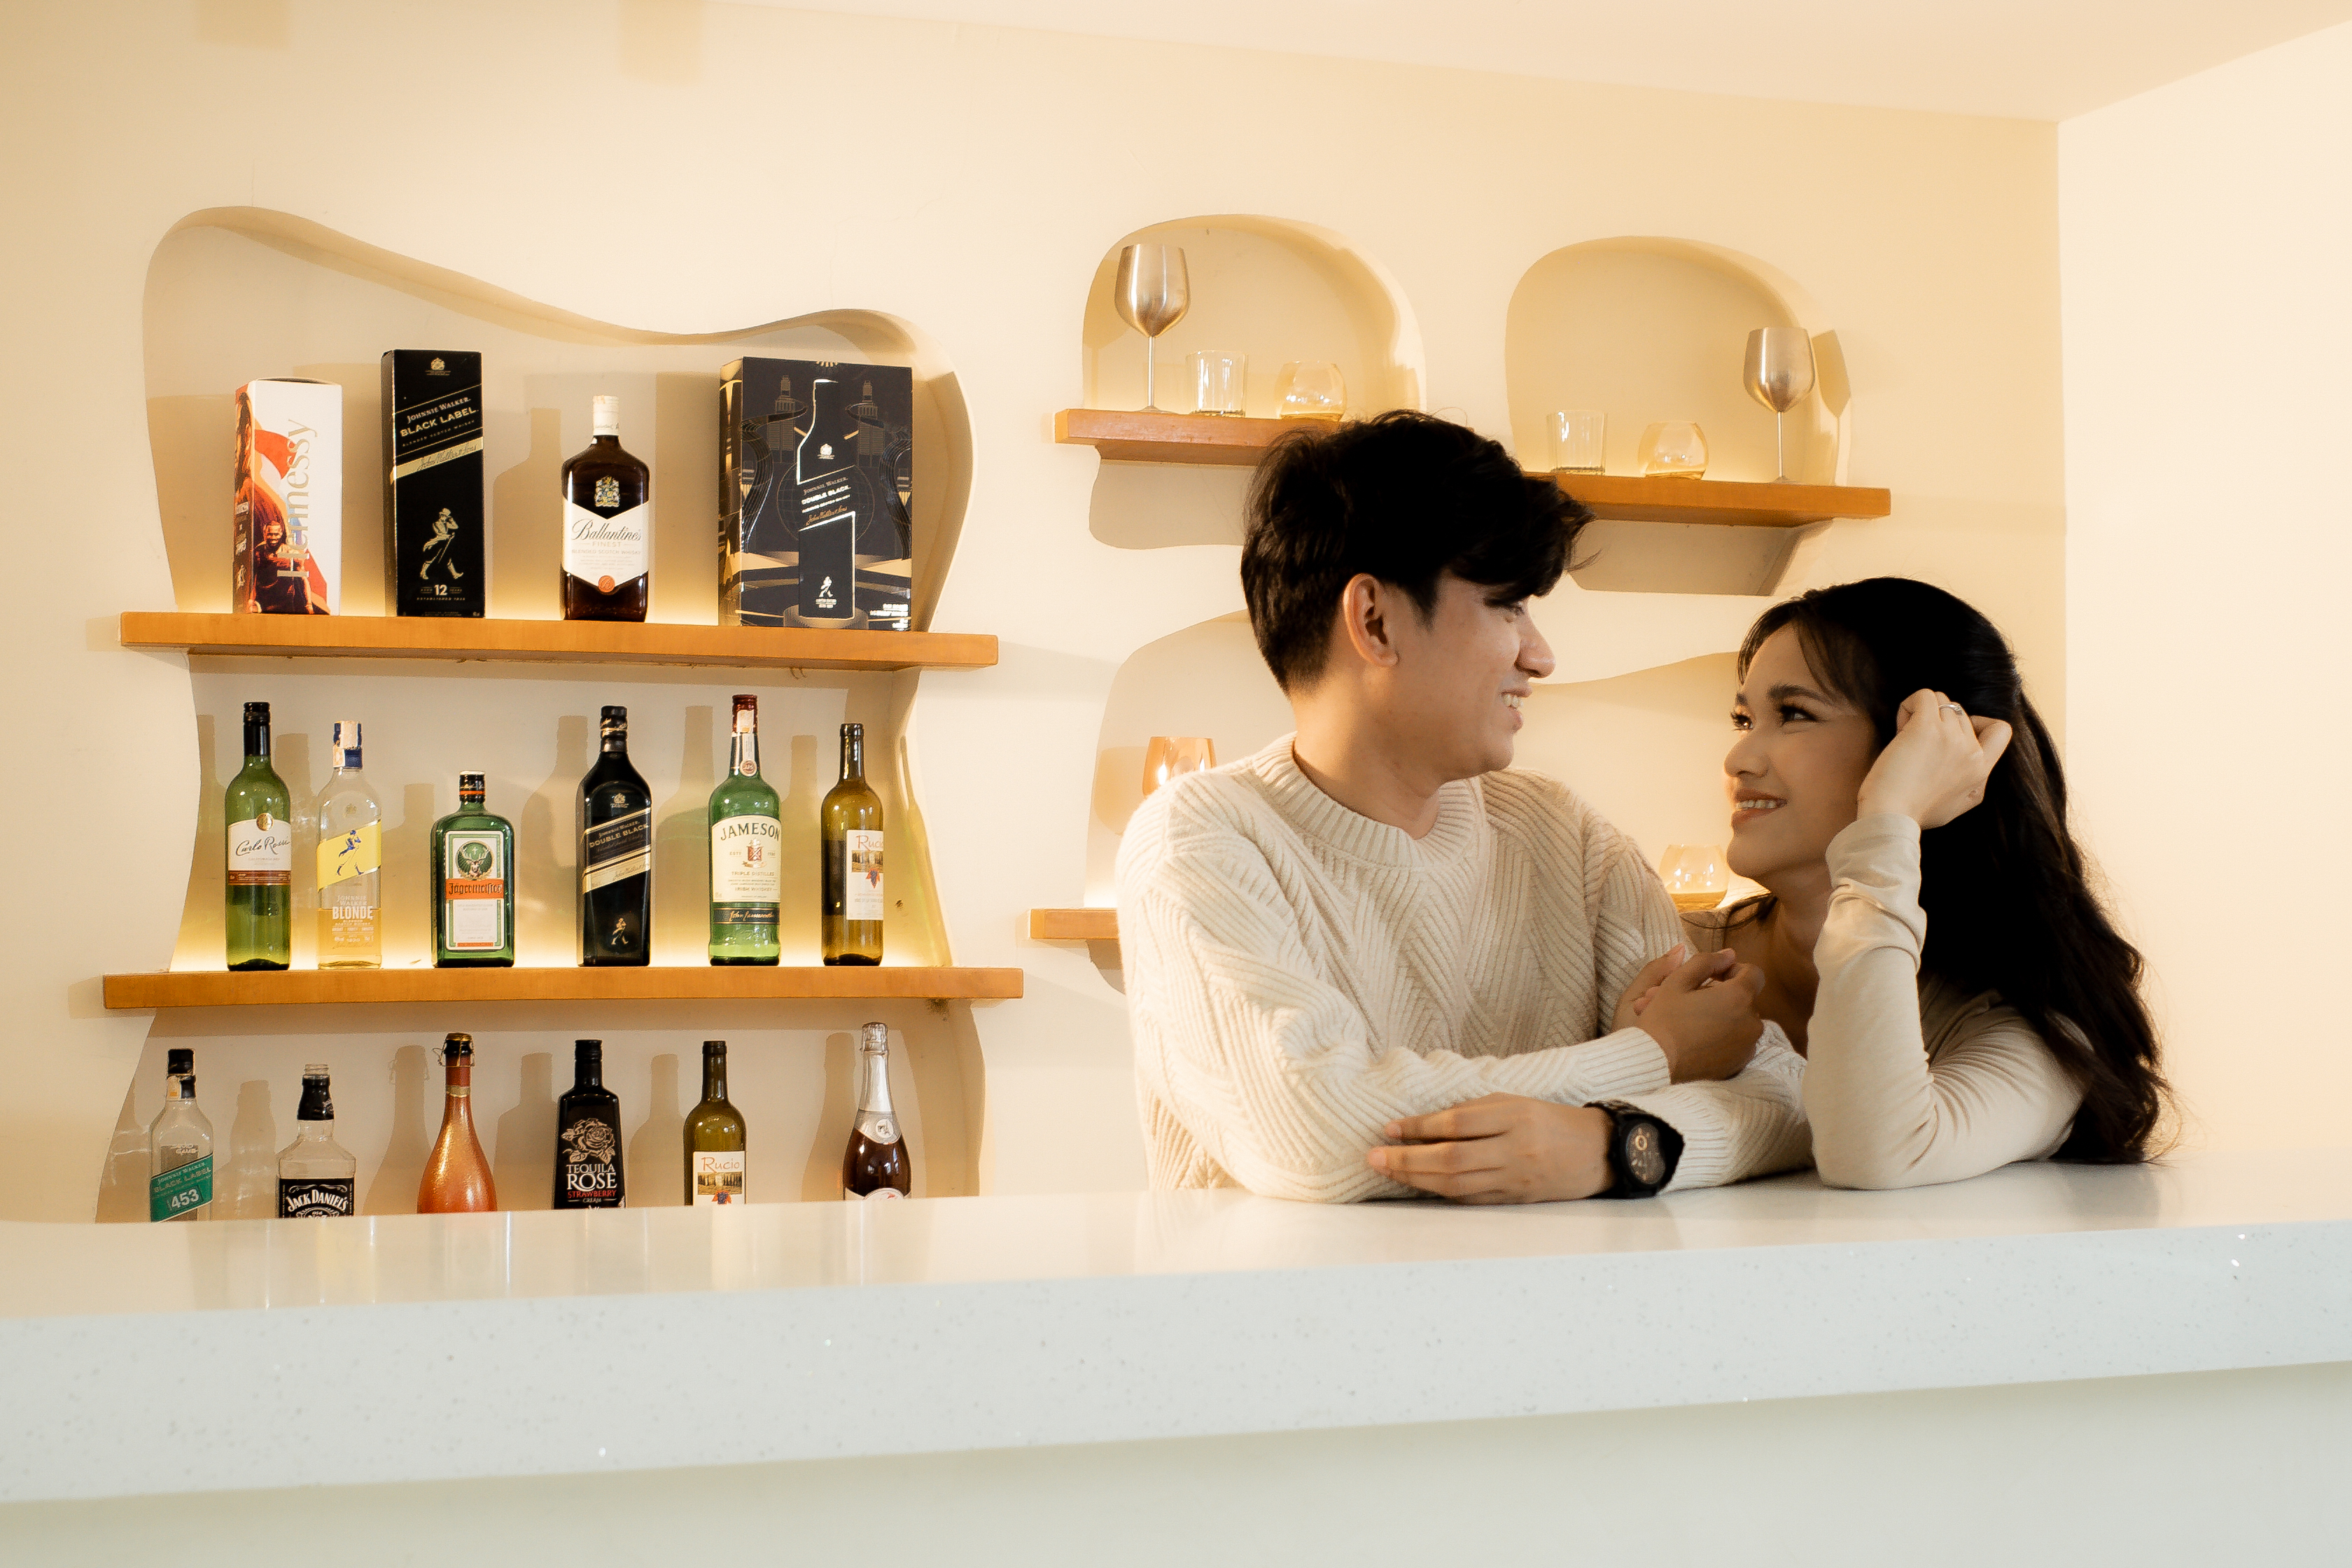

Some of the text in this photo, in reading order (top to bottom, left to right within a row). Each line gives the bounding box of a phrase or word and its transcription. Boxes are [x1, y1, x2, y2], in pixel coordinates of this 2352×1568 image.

[400, 419, 438, 437] BLACK
[276, 419, 317, 578] Hennessy
[571, 518, 642, 542] Ballantine's
[434, 584, 448, 596] 12
[589, 833, 622, 848] DOUBLE
[720, 822, 780, 841] JAMESON
[236, 839, 262, 856] Carlo
[332, 905, 374, 920] BLONDE
[566, 1163, 615, 1174] TEQUILA
[701, 1156, 740, 1174] Rucio
[153, 1178, 182, 1193] BLACK
[183, 1167, 211, 1182] LABEL
[566, 1172, 617, 1192] ROSE
[172, 1189, 200, 1208] 453
[286, 1193, 312, 1212] JACK
[312, 1189, 349, 1212] DANIEL'S
[568, 1190, 617, 1198] STRAWBERRY
